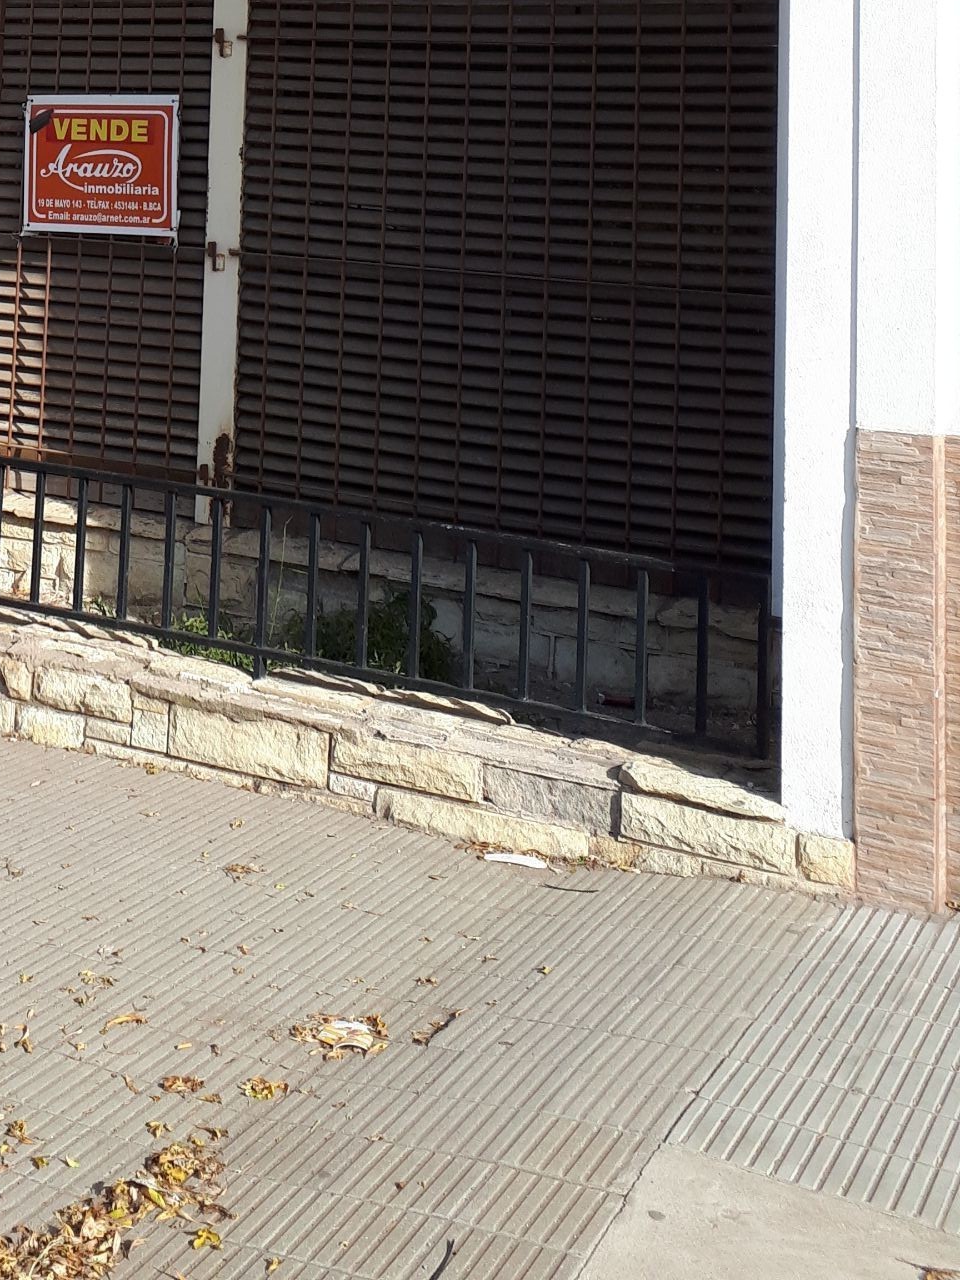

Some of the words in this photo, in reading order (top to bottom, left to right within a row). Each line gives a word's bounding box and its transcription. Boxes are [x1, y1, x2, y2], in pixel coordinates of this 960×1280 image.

[52, 118, 149, 142] VENDE
[40, 144, 137, 178] Arauzo
[84, 182, 160, 195] inmobiliaria
[46, 199, 54, 208] DE
[54, 199, 71, 208] MAYO
[72, 200, 82, 208] 143
[48, 211, 70, 220] Email:
[72, 213, 150, 223] arauzo@arnet.com.ar
